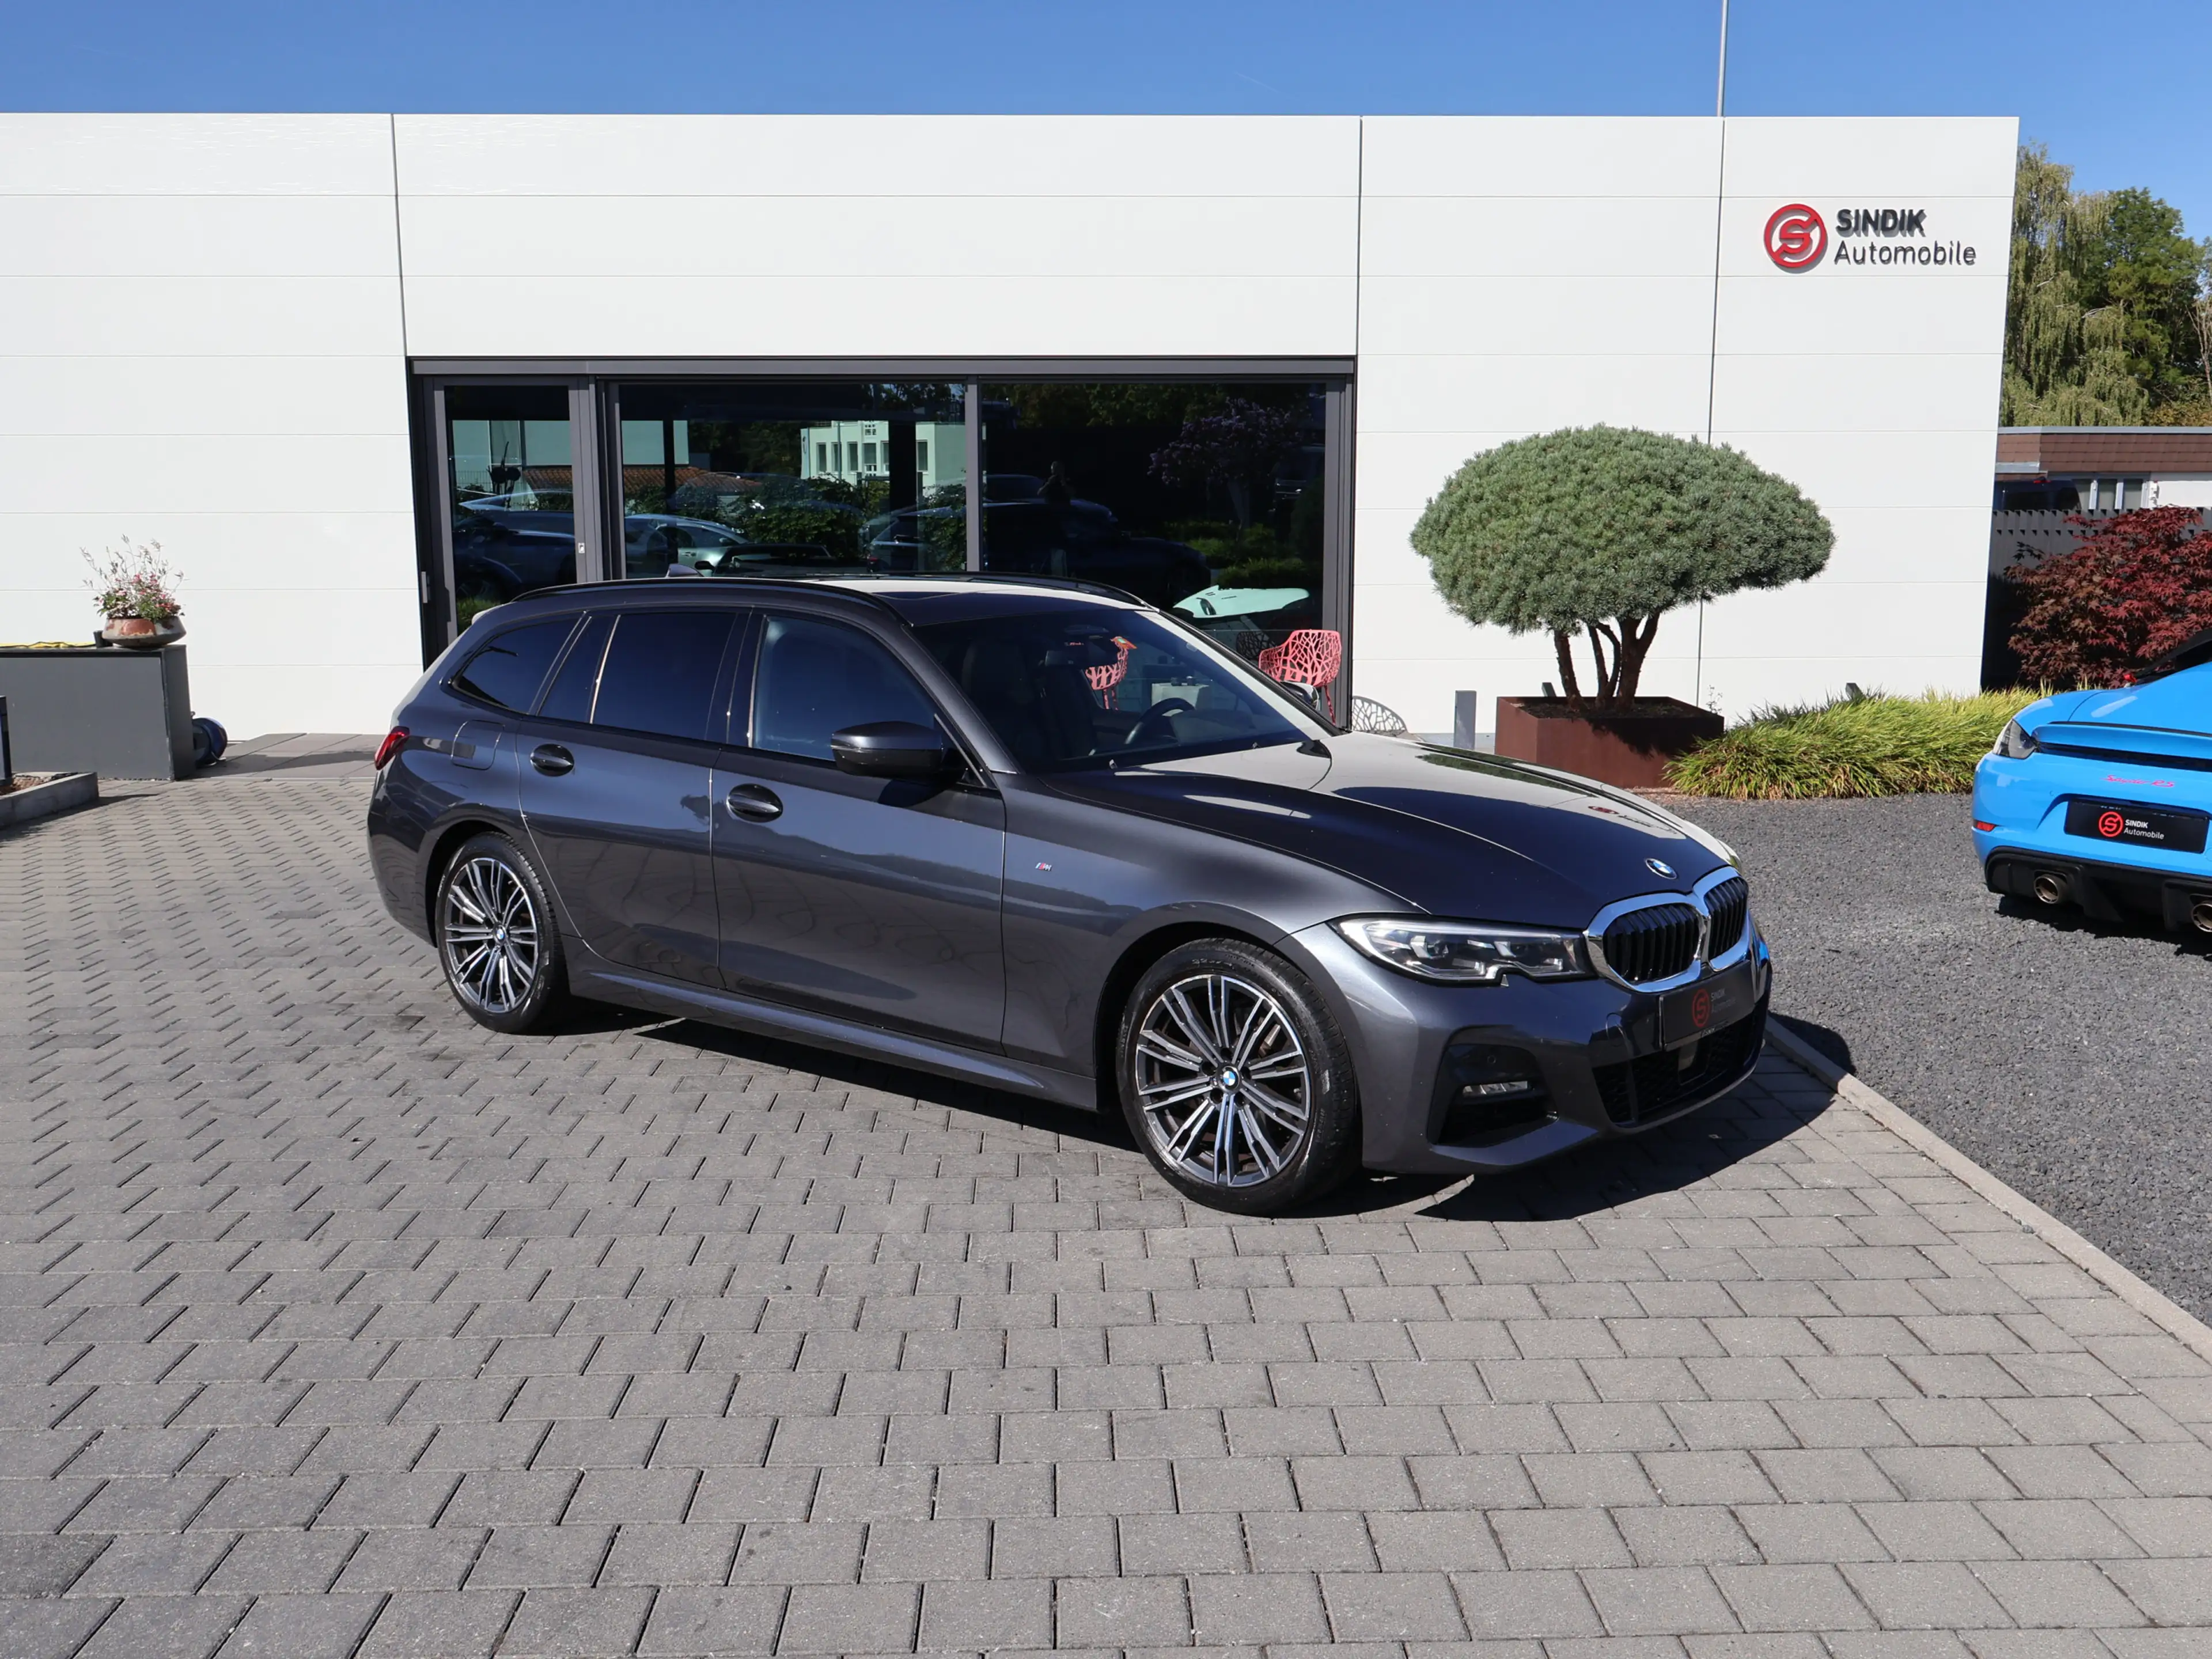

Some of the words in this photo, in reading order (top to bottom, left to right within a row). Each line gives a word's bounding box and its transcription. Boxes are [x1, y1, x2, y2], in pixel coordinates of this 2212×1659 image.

[1835, 209, 1926, 236] SINDIK
[1834, 240, 1976, 266] Automobile
[2151, 779, 2175, 787] RS
[2125, 819, 2148, 828] SINDIK
[2124, 828, 2164, 839] Automobile
